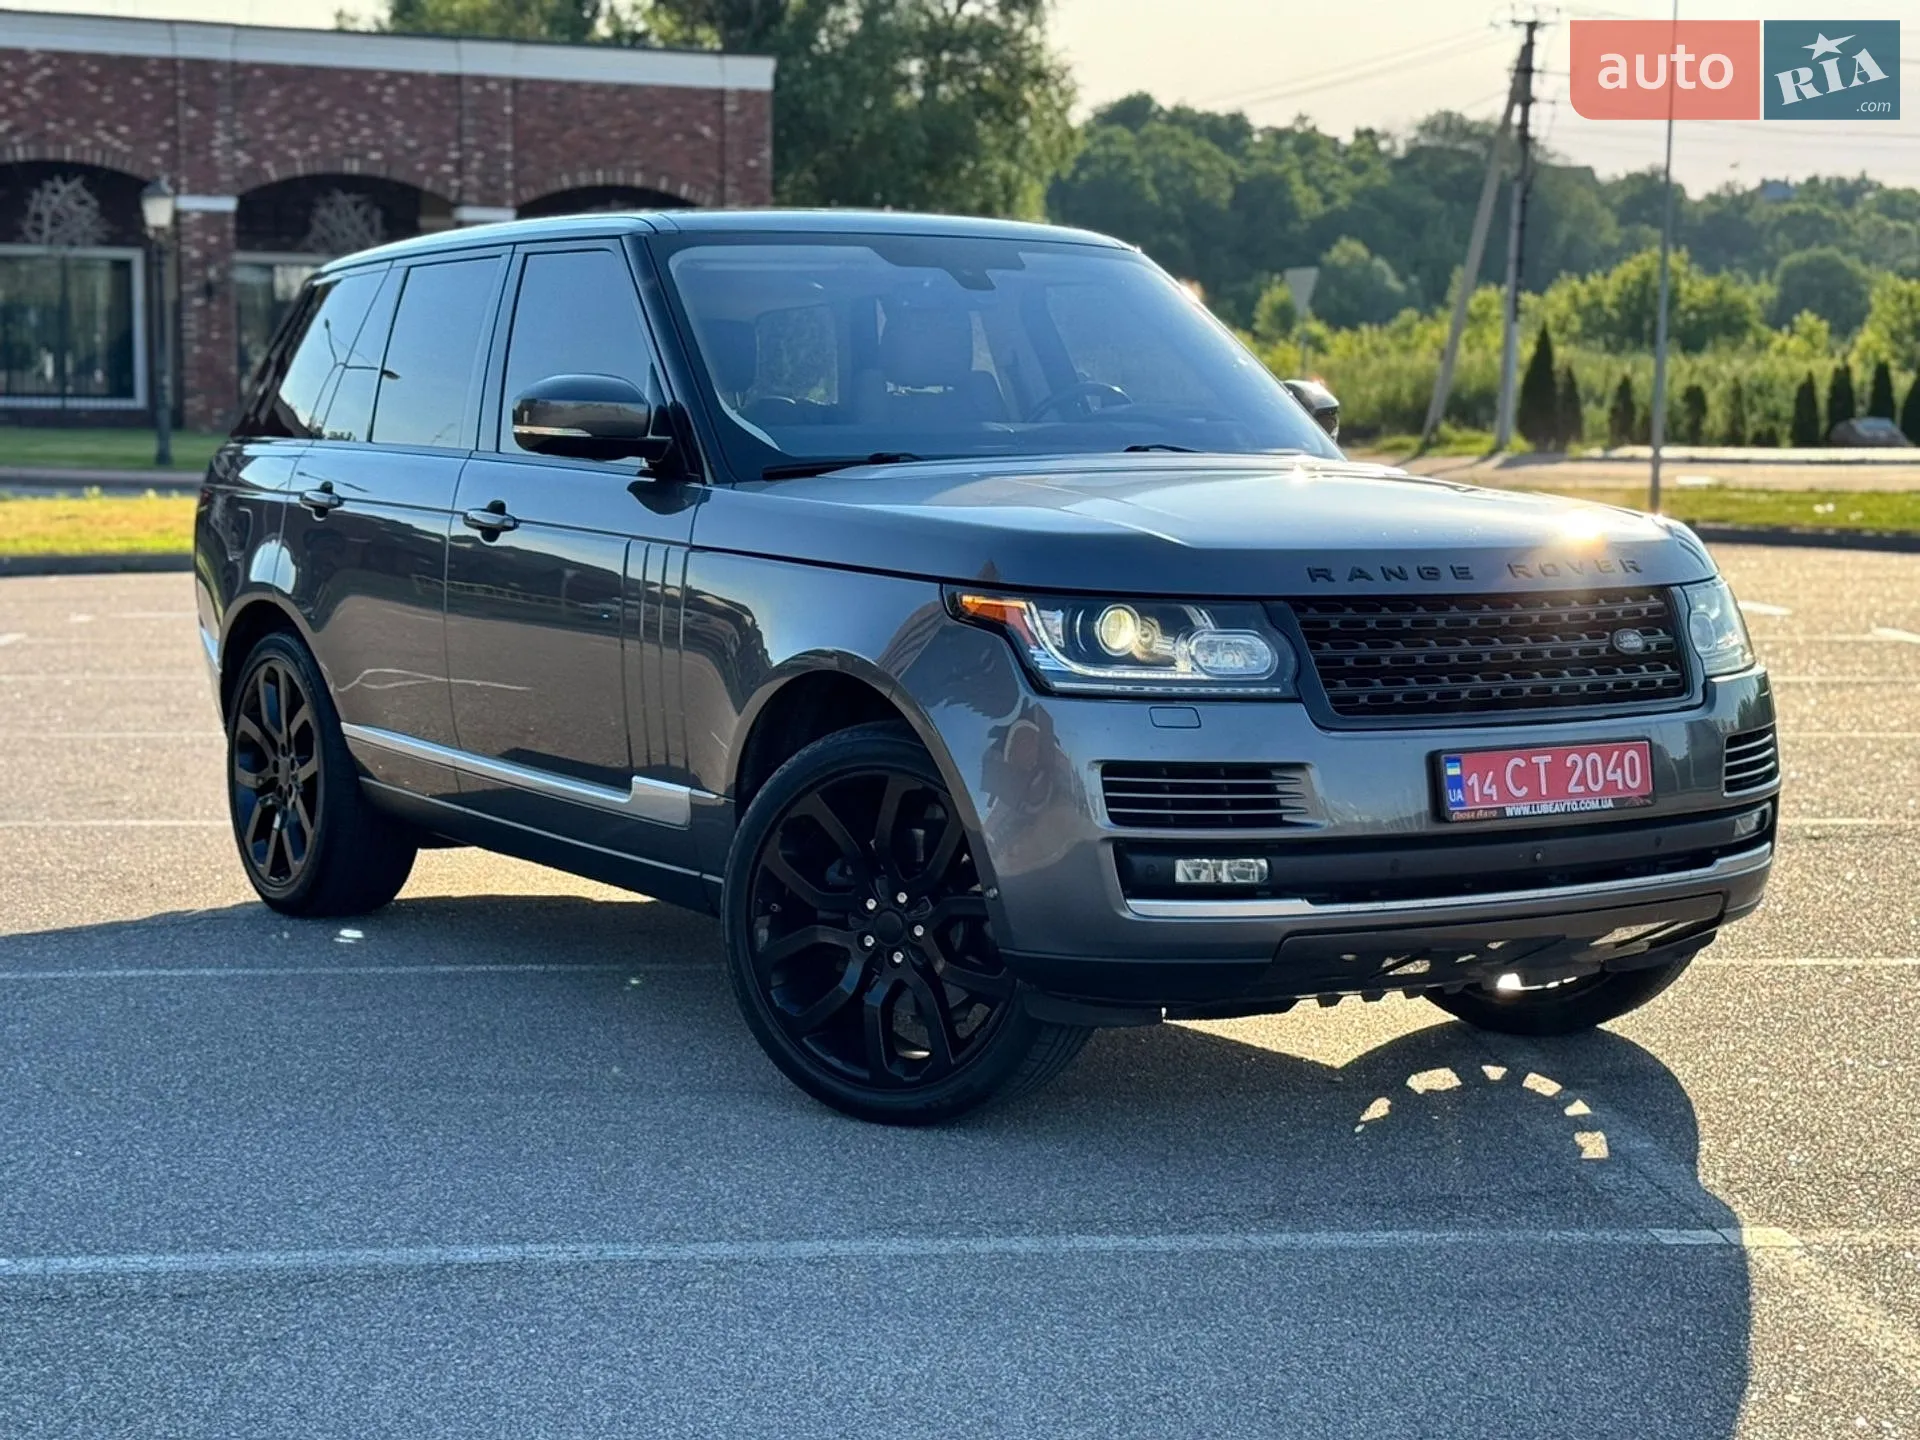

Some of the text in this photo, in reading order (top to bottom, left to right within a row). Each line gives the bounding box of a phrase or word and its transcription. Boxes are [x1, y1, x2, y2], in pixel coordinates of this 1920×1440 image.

[1307, 558, 1643, 584] RANGE ROVER
[1467, 749, 1642, 803] 14 CT 2040
[1448, 789, 1464, 802] UA
